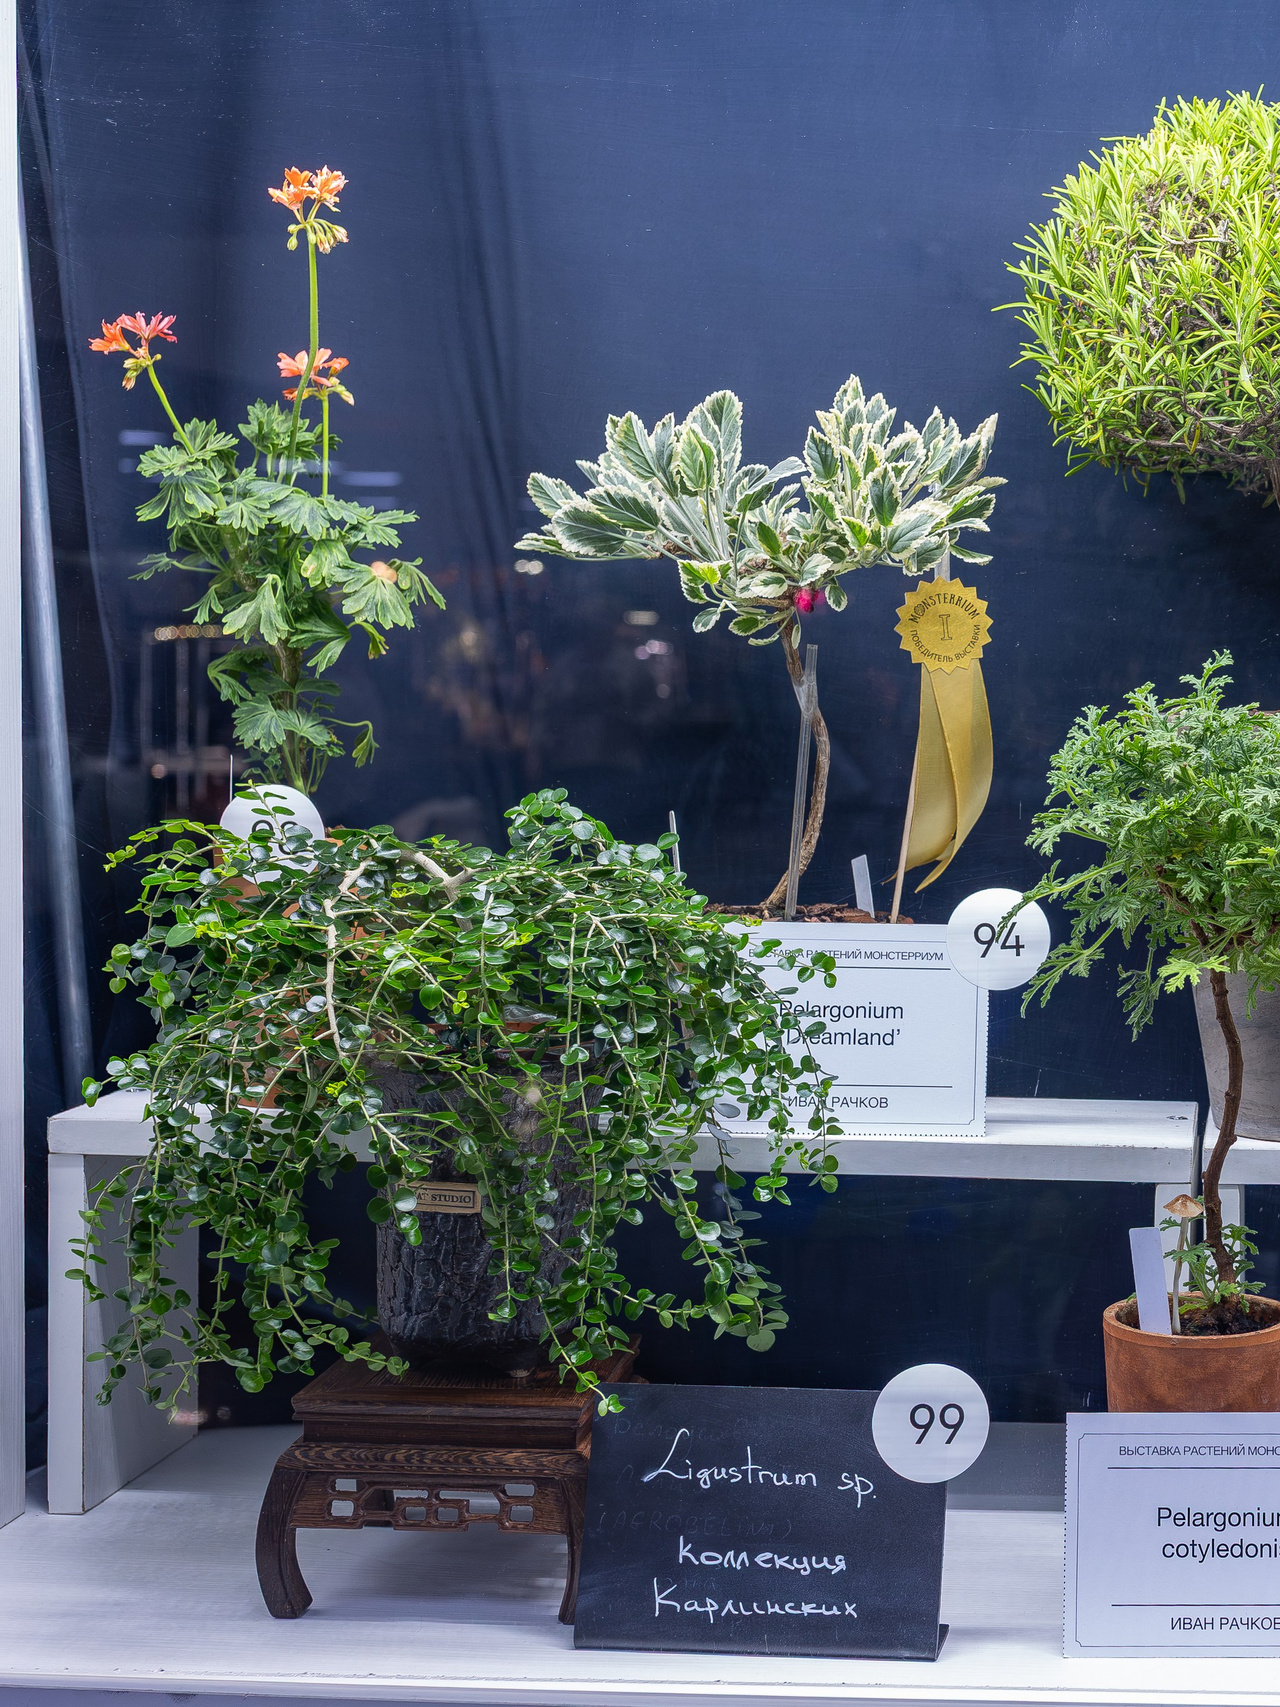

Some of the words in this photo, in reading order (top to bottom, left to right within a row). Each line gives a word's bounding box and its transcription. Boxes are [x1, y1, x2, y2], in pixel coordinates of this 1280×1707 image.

[908, 592, 980, 624] MONSTERRIUM
[910, 629, 954, 663] ПОБЕДИТЕЛЬ
[954, 624, 981, 661] ВЫСТАВКИ
[973, 921, 1026, 958] 94
[805, 948, 863, 960] РТЕНИЙ
[863, 950, 945, 961] МОНСТЕРРИУМ
[779, 1000, 904, 1023] Pelargonium
[831, 1096, 889, 1109] РАЧКОВ
[430, 1193, 472, 1204] STUDIO
[908, 1403, 965, 1445] 99
[1118, 1445, 1181, 1456] ВЫСТАВКА
[1183, 1444, 1246, 1456] РАСТЕНИЙ
[641, 1428, 817, 1488] Ligustrum
[837, 1475, 877, 1508] sp.
[653, 1577, 858, 1623] Карлинских
[1170, 1617, 1215, 1631] ИВАН
